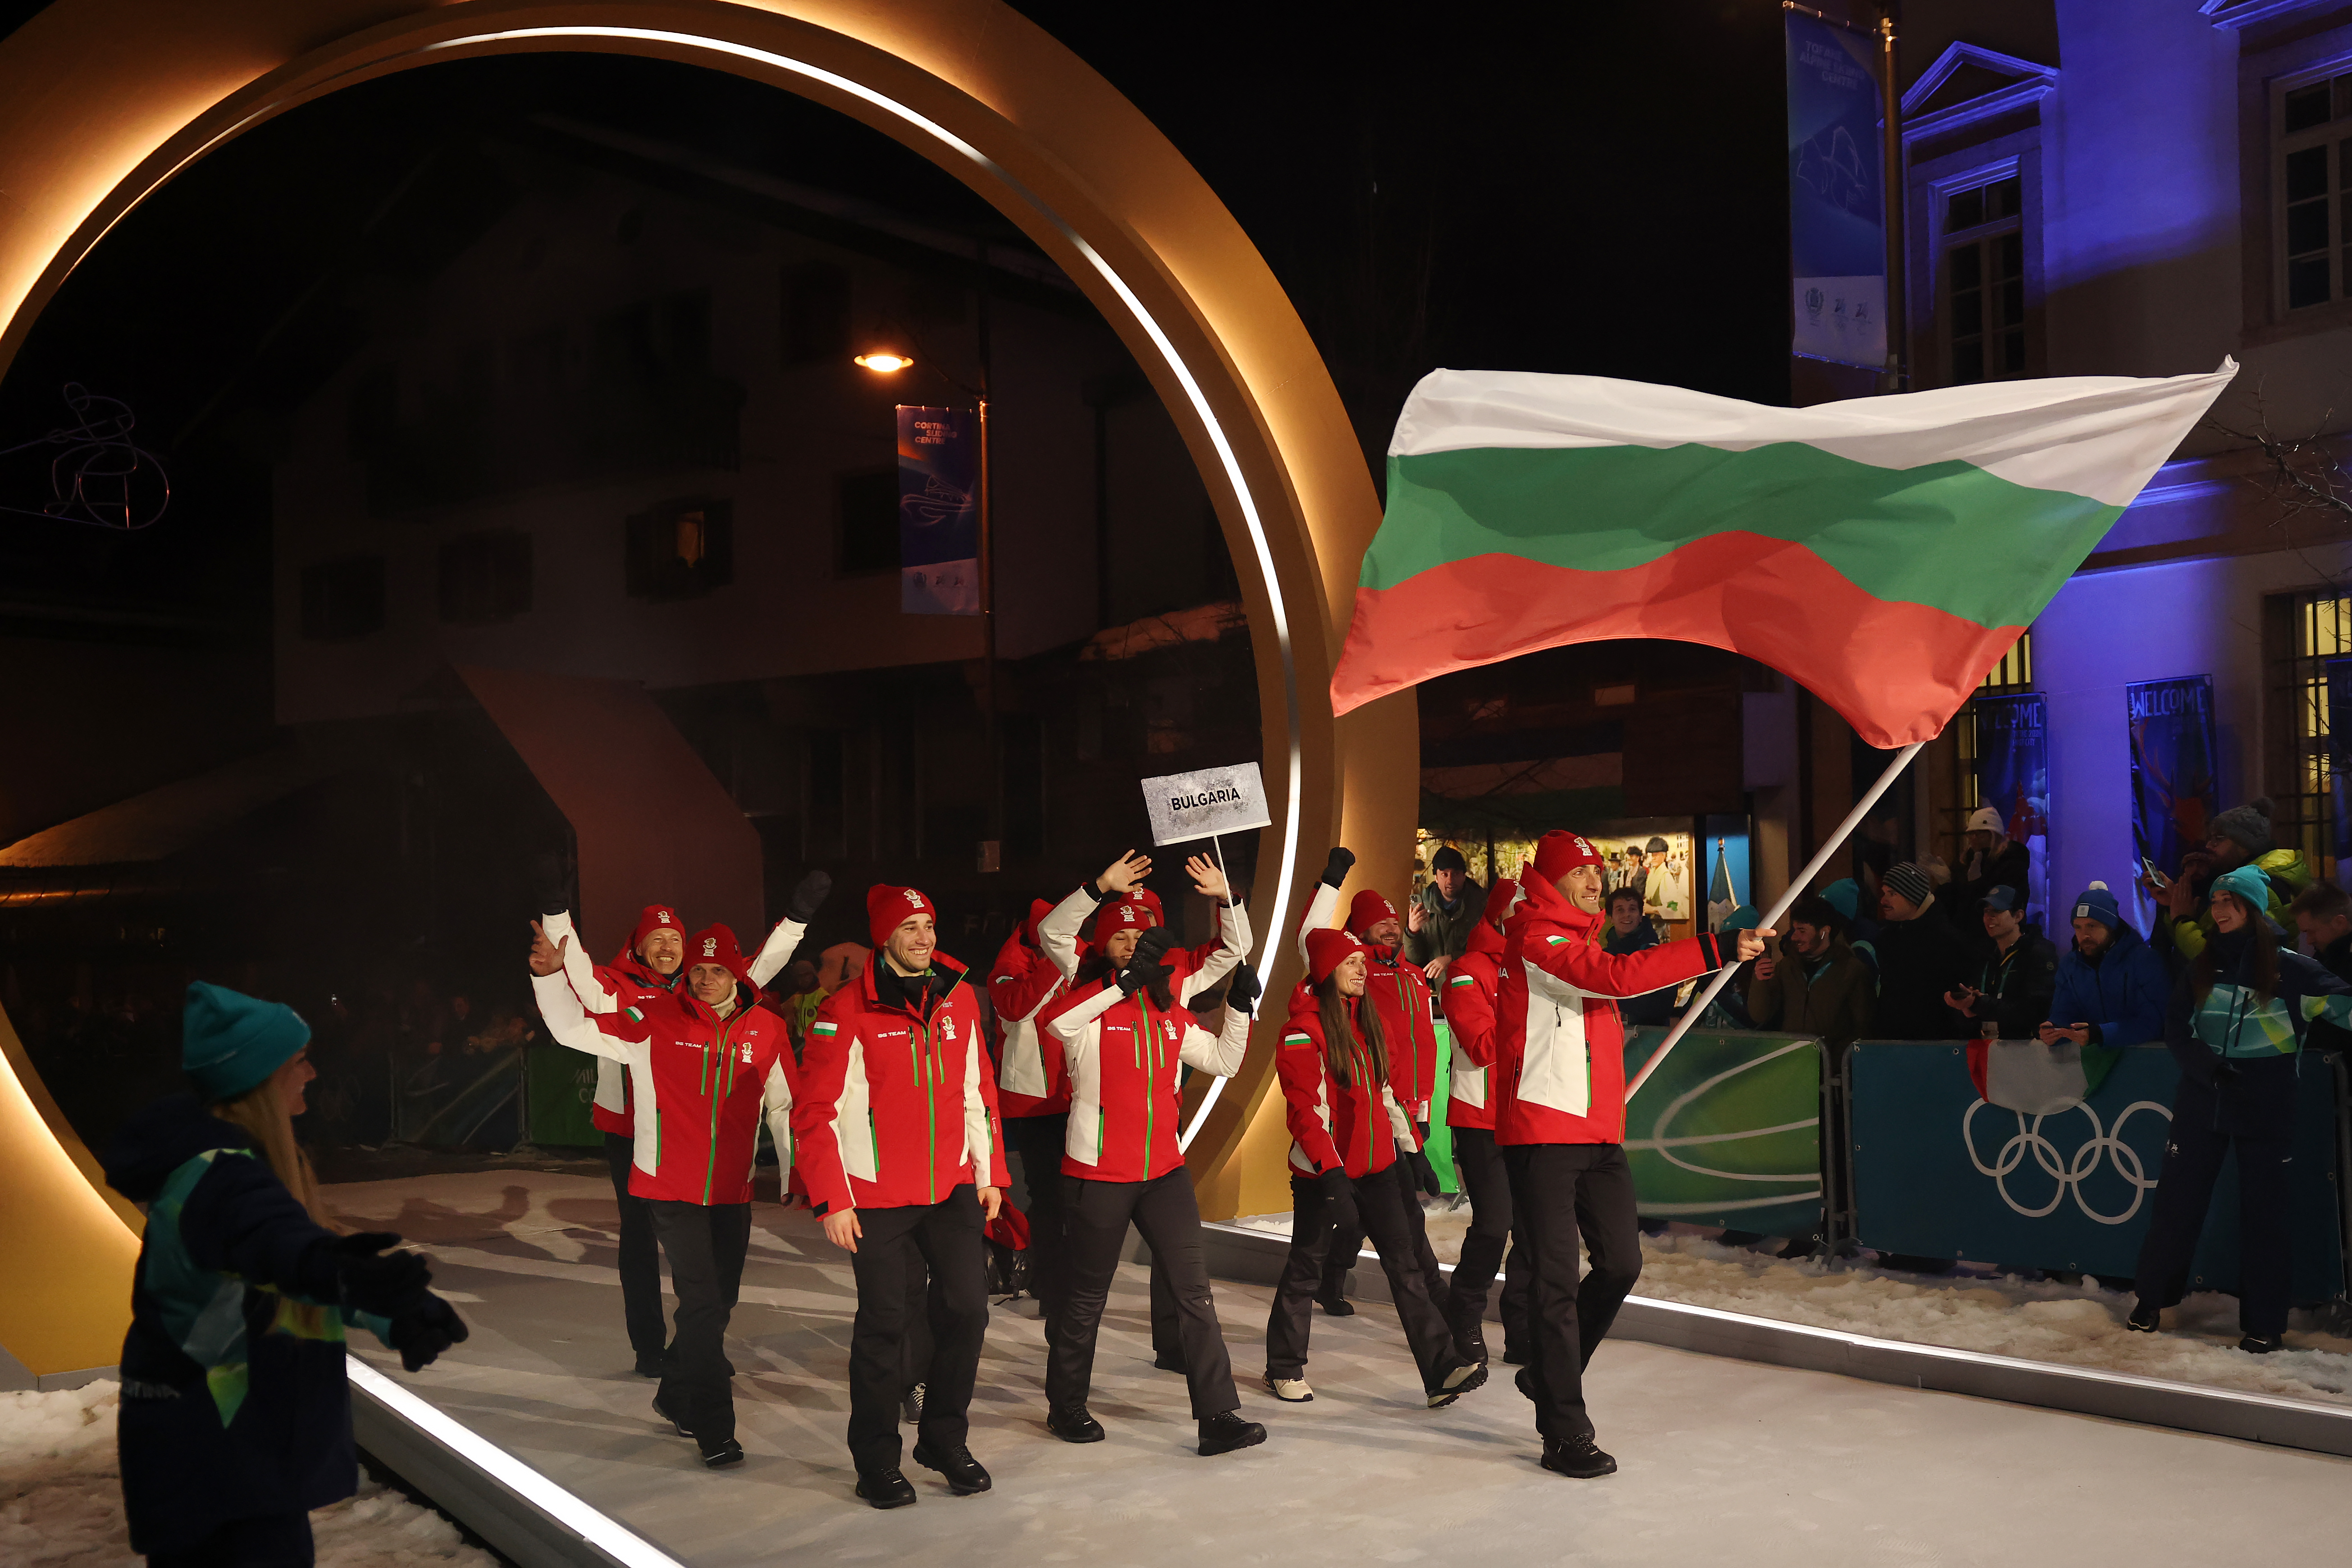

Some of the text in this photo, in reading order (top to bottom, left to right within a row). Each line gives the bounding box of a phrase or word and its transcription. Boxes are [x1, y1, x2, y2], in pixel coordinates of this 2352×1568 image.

[1822, 70, 1858, 90] CENTRE
[914, 421, 950, 430] CORTINA
[914, 436, 945, 444] CENTRE
[926, 429, 957, 438] SLIDING
[2130, 686, 2205, 718] WELCOME
[1171, 787, 1241, 811] BULGARIA
